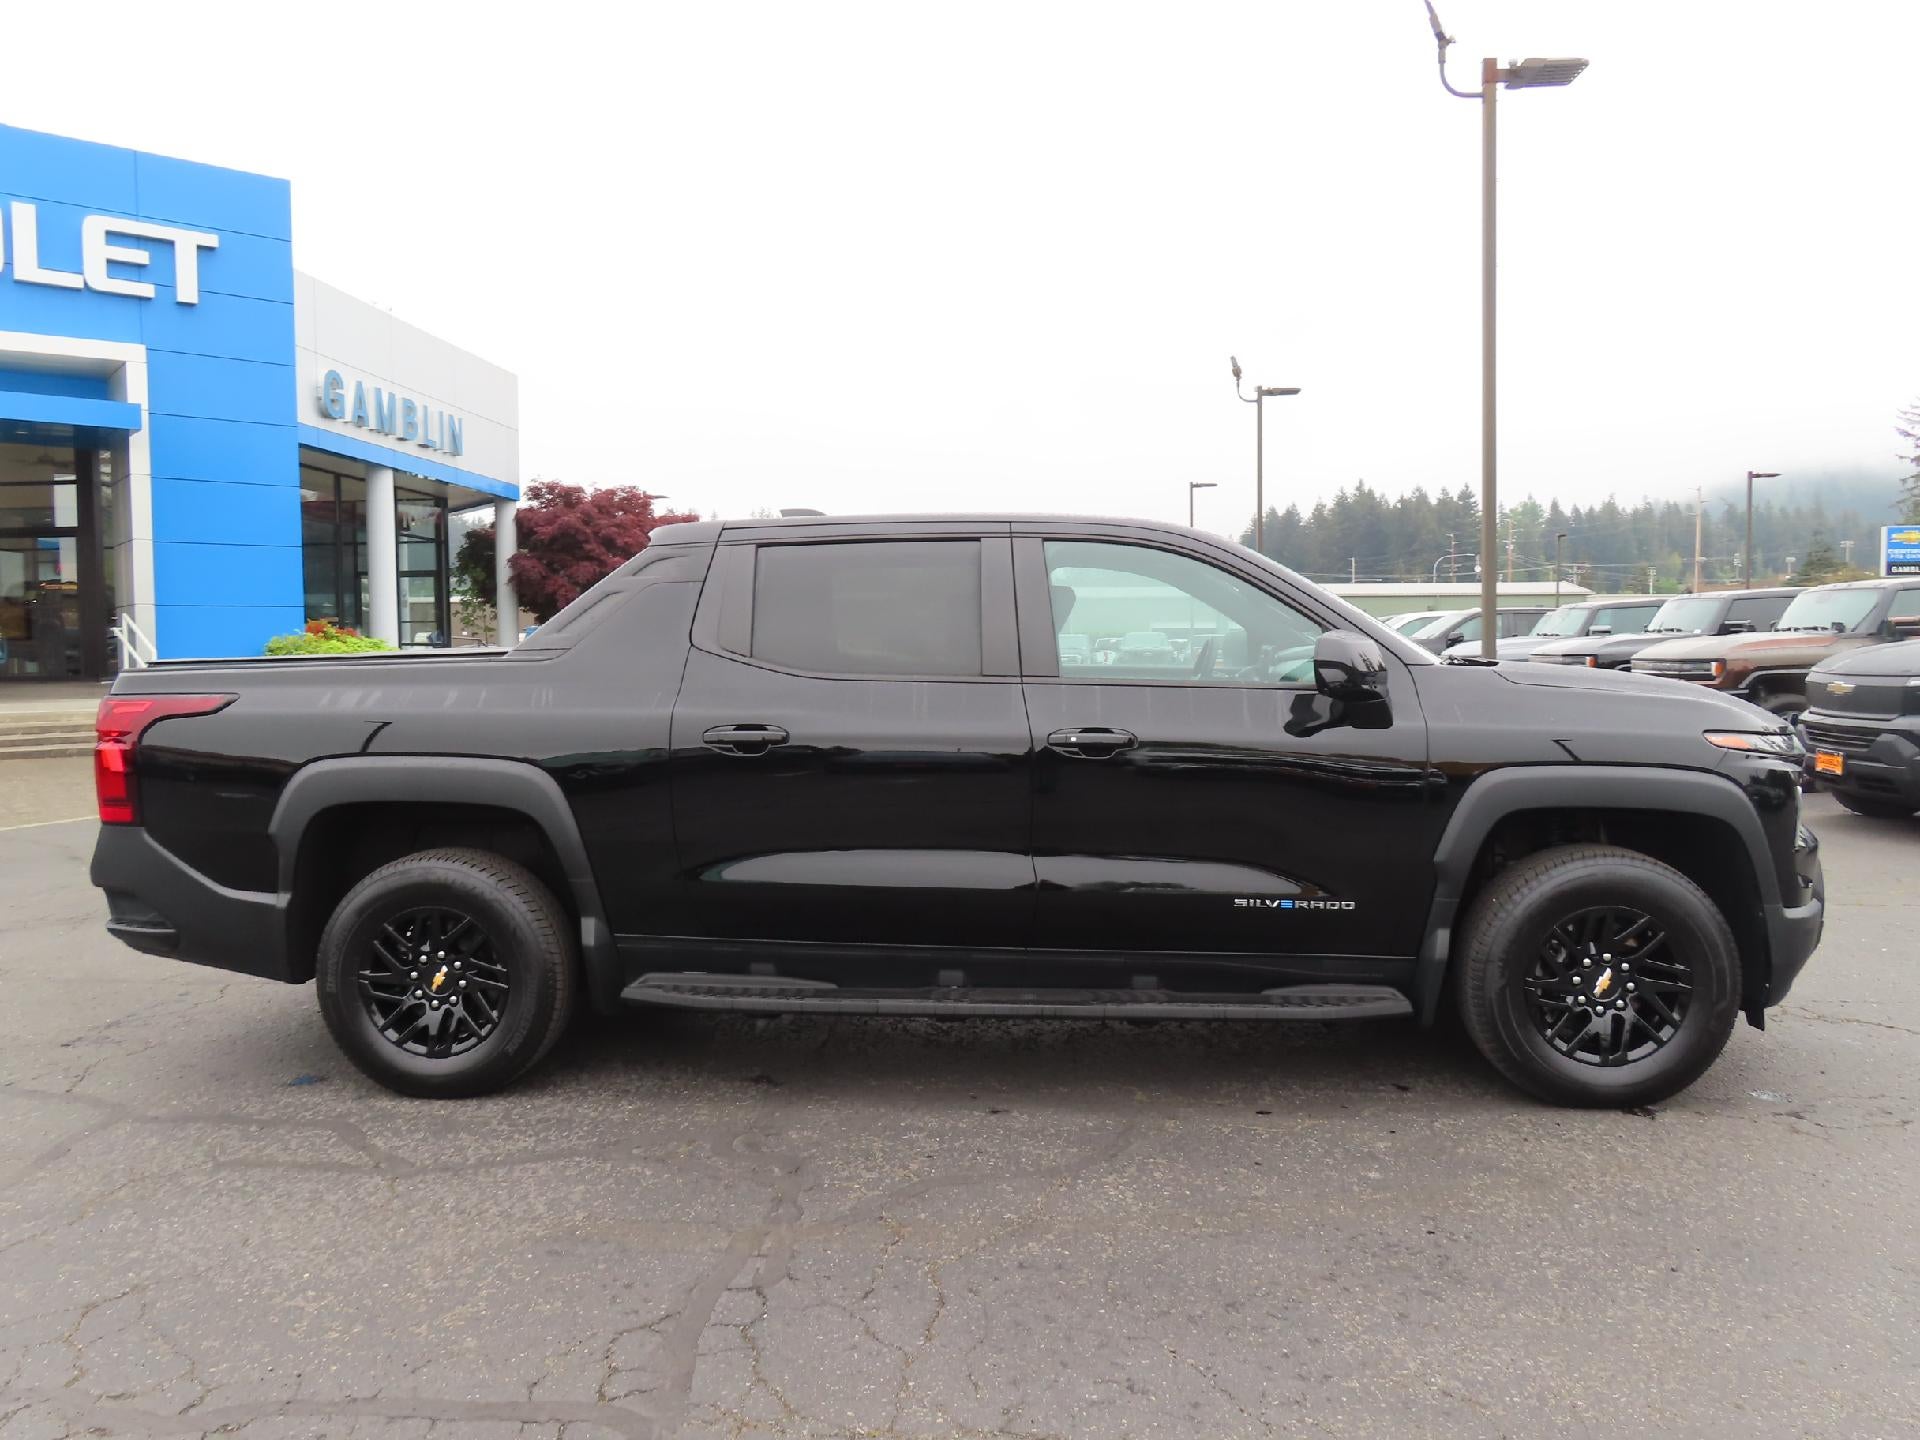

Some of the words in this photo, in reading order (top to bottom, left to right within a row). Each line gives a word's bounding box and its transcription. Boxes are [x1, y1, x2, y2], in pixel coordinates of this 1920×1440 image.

[0, 201, 220, 305] LET
[321, 369, 464, 457] GAMBLIN
[1233, 898, 1356, 910] SILVERADO
